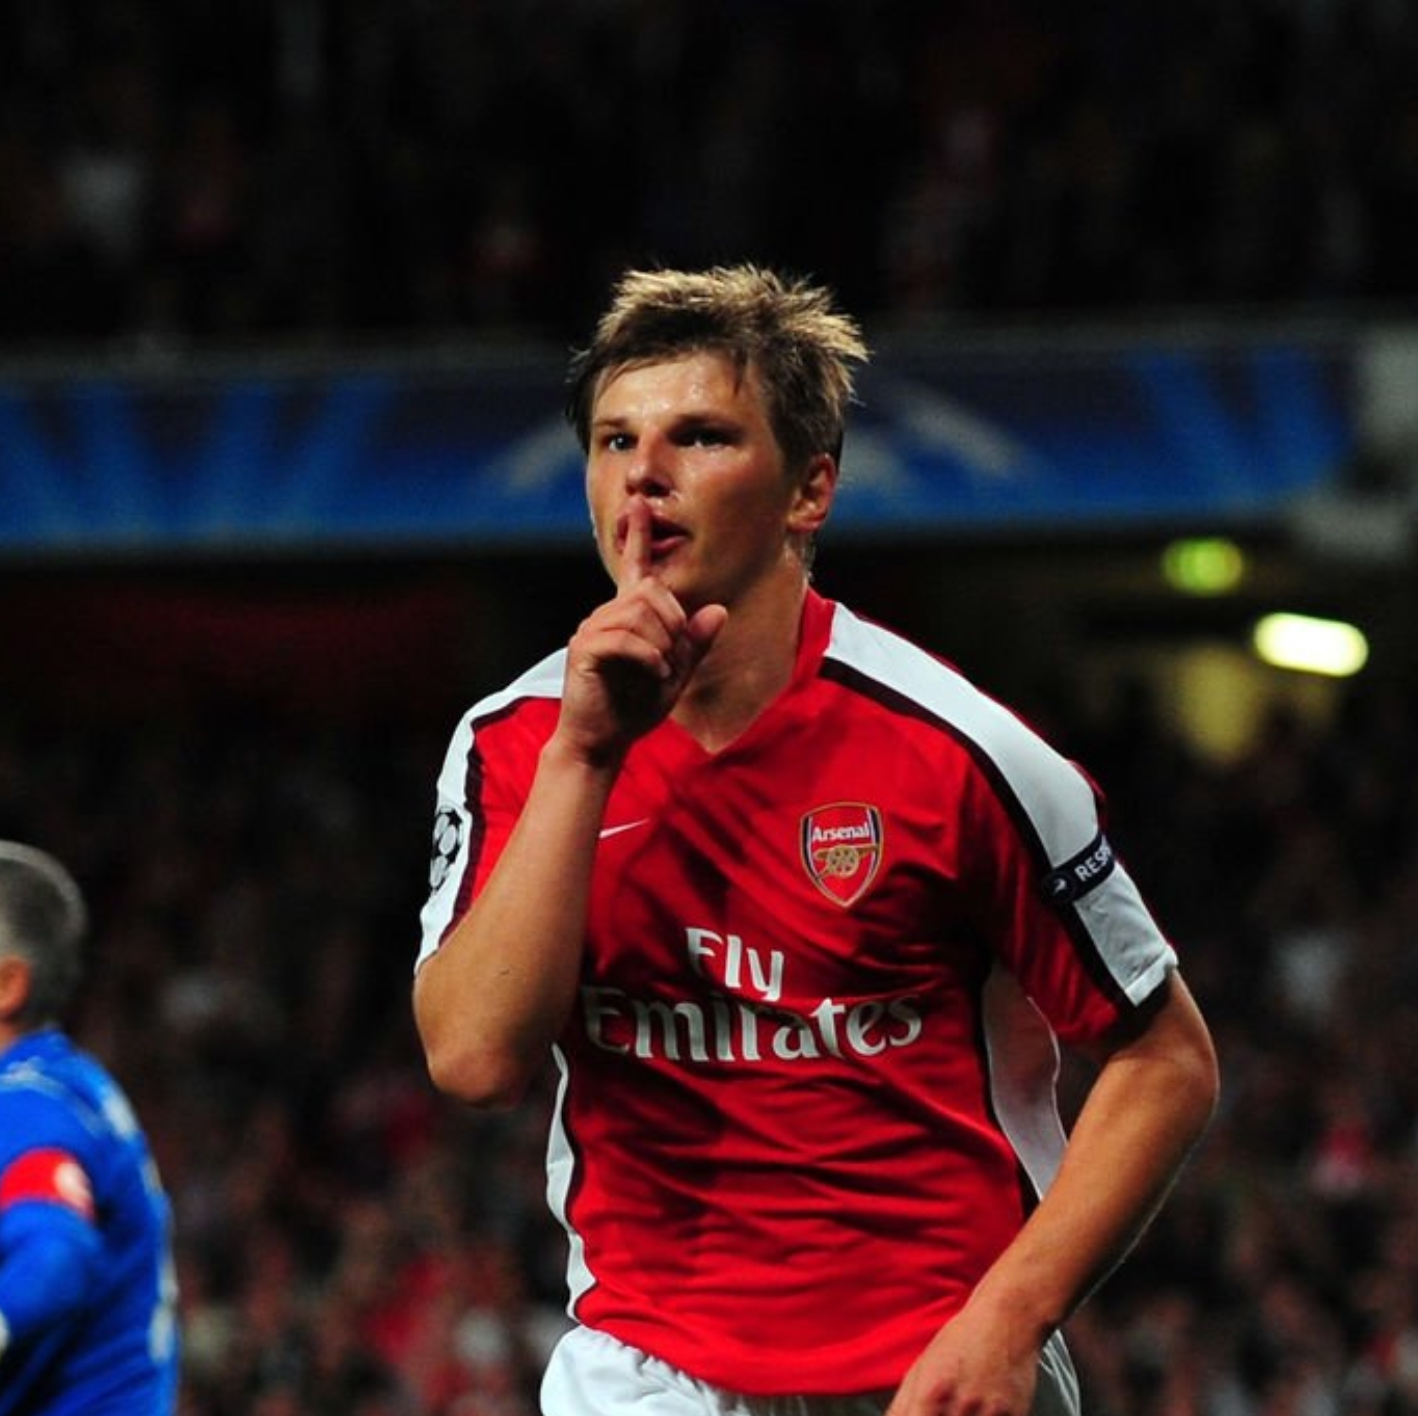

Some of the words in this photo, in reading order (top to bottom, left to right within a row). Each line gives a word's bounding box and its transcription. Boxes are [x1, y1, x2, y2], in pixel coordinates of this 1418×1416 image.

[812, 821, 870, 842] Arsenal
[685, 927, 784, 1001] Fly
[581, 985, 923, 1062] Emirates
